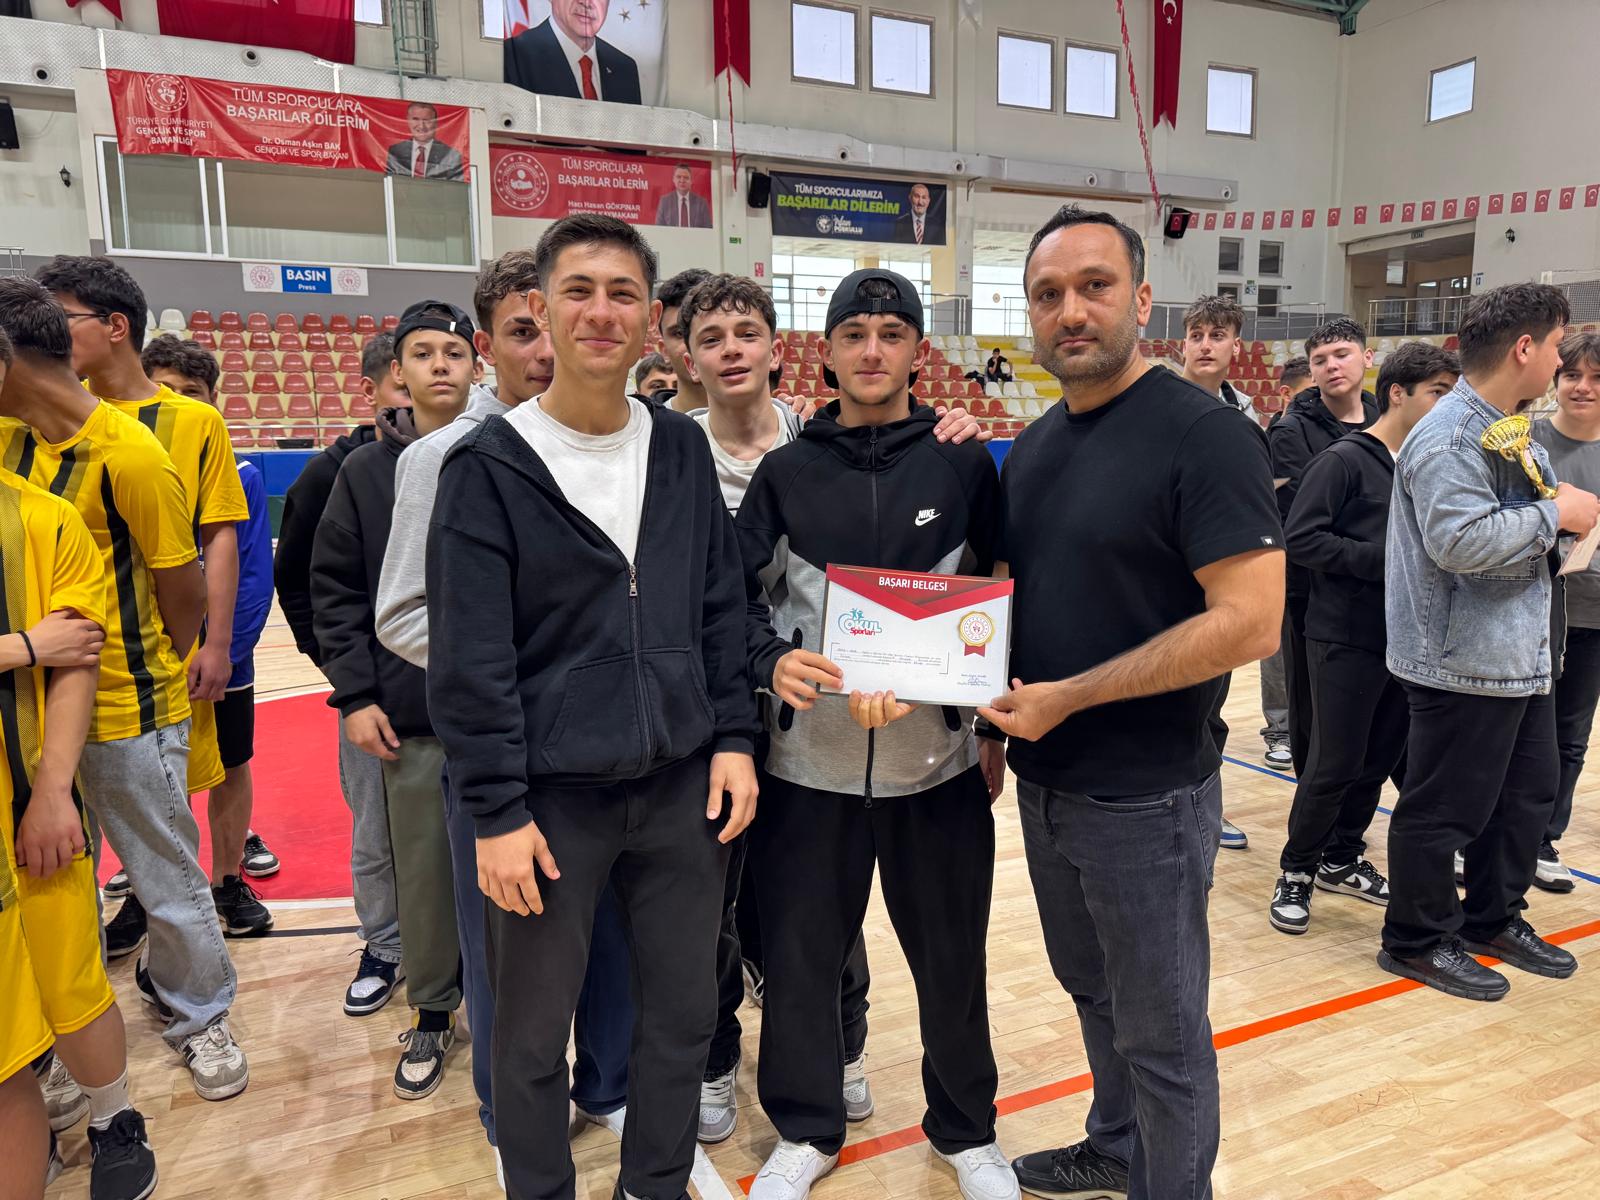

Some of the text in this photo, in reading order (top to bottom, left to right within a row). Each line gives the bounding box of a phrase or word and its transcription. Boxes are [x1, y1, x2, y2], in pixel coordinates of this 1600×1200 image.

[233, 87, 363, 113] TÜM SPORCULARA
[226, 104, 370, 131] BAŞARILAR DİLERİM
[136, 126, 172, 137] GENÇLİK
[184, 129, 206, 138] SPOR
[262, 136, 341, 150] Dr. Osman Aşkın BAK
[254, 145, 288, 156] GENÇLİK
[288, 148, 300, 156] VE
[301, 150, 321, 159] SPOR
[561, 157, 644, 175] TÜM SPORCULARA
[558, 174, 649, 191] BAŞARILAR DİLERİM
[794, 182, 883, 200] TÜM SPORCULARIMIZA
[777, 195, 900, 215] BAŞARILAR DİLERİM
[286, 269, 327, 282] BASIN
[298, 283, 317, 291] Press
[918, 508, 936, 519] NIKE
[878, 576, 948, 592] BAŞARI BELGESİ
